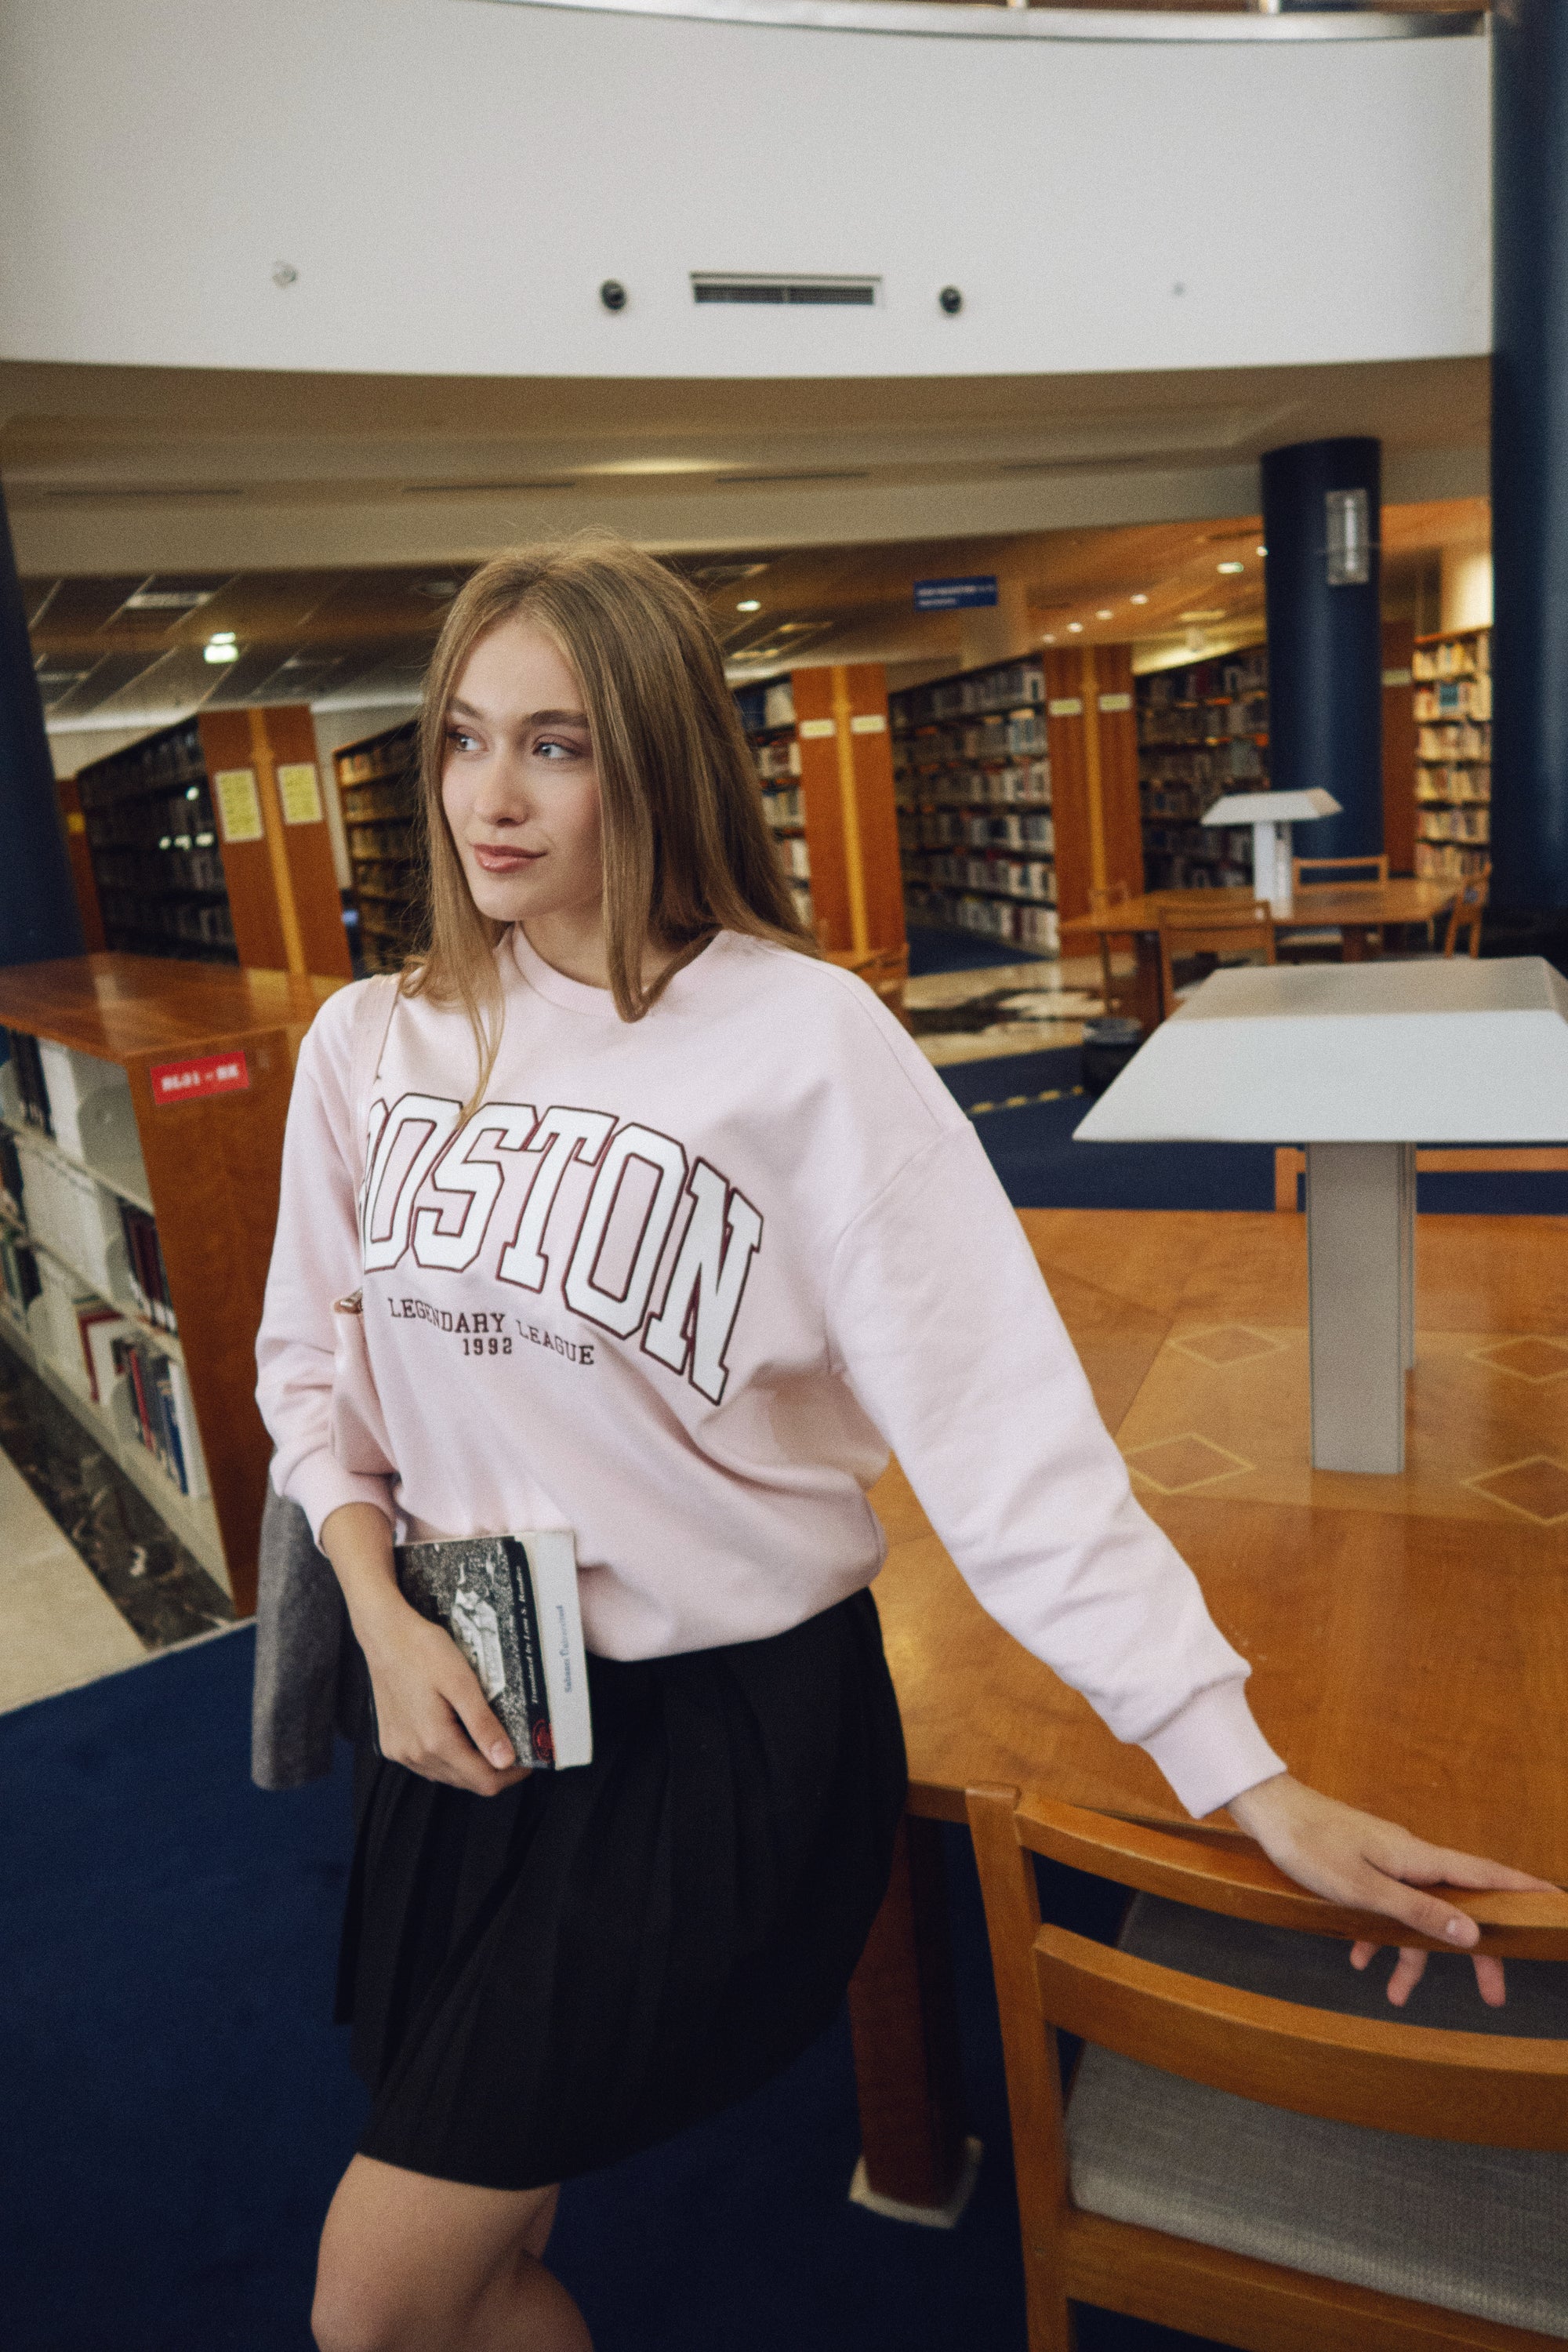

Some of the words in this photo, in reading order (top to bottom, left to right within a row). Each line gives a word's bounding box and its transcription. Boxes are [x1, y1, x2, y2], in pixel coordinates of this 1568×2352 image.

[387, 1298, 507, 1334] LEGENDARY
[516, 1319, 595, 1366] LEAGUE
[462, 1338, 513, 1356] 1992
